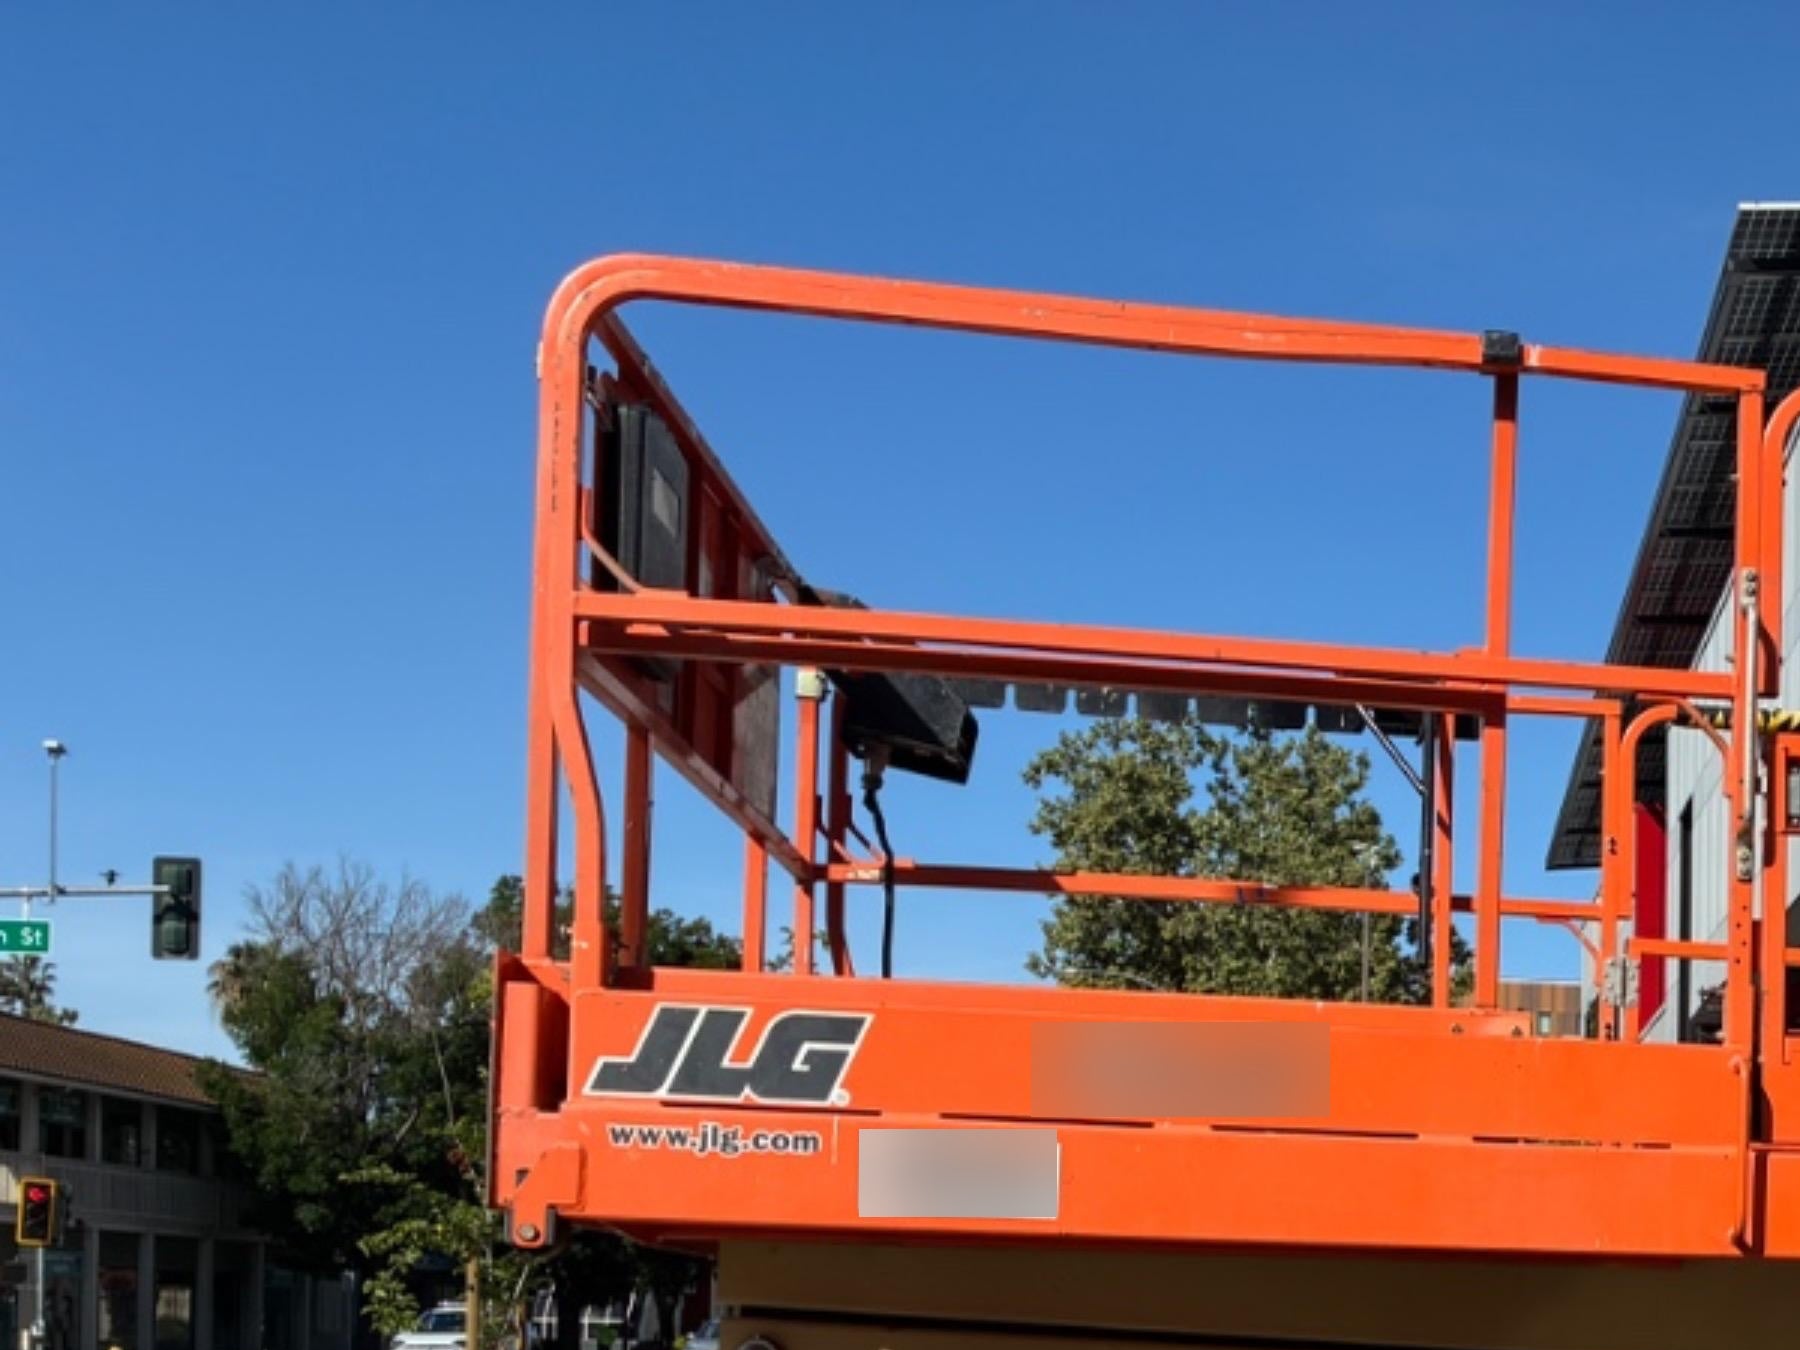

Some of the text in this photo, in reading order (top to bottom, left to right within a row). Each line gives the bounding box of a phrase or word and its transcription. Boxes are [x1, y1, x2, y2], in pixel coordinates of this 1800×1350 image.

[20, 926, 43, 947] St
[583, 1001, 874, 1106] JLG
[608, 1124, 820, 1154] www.jlg.com
